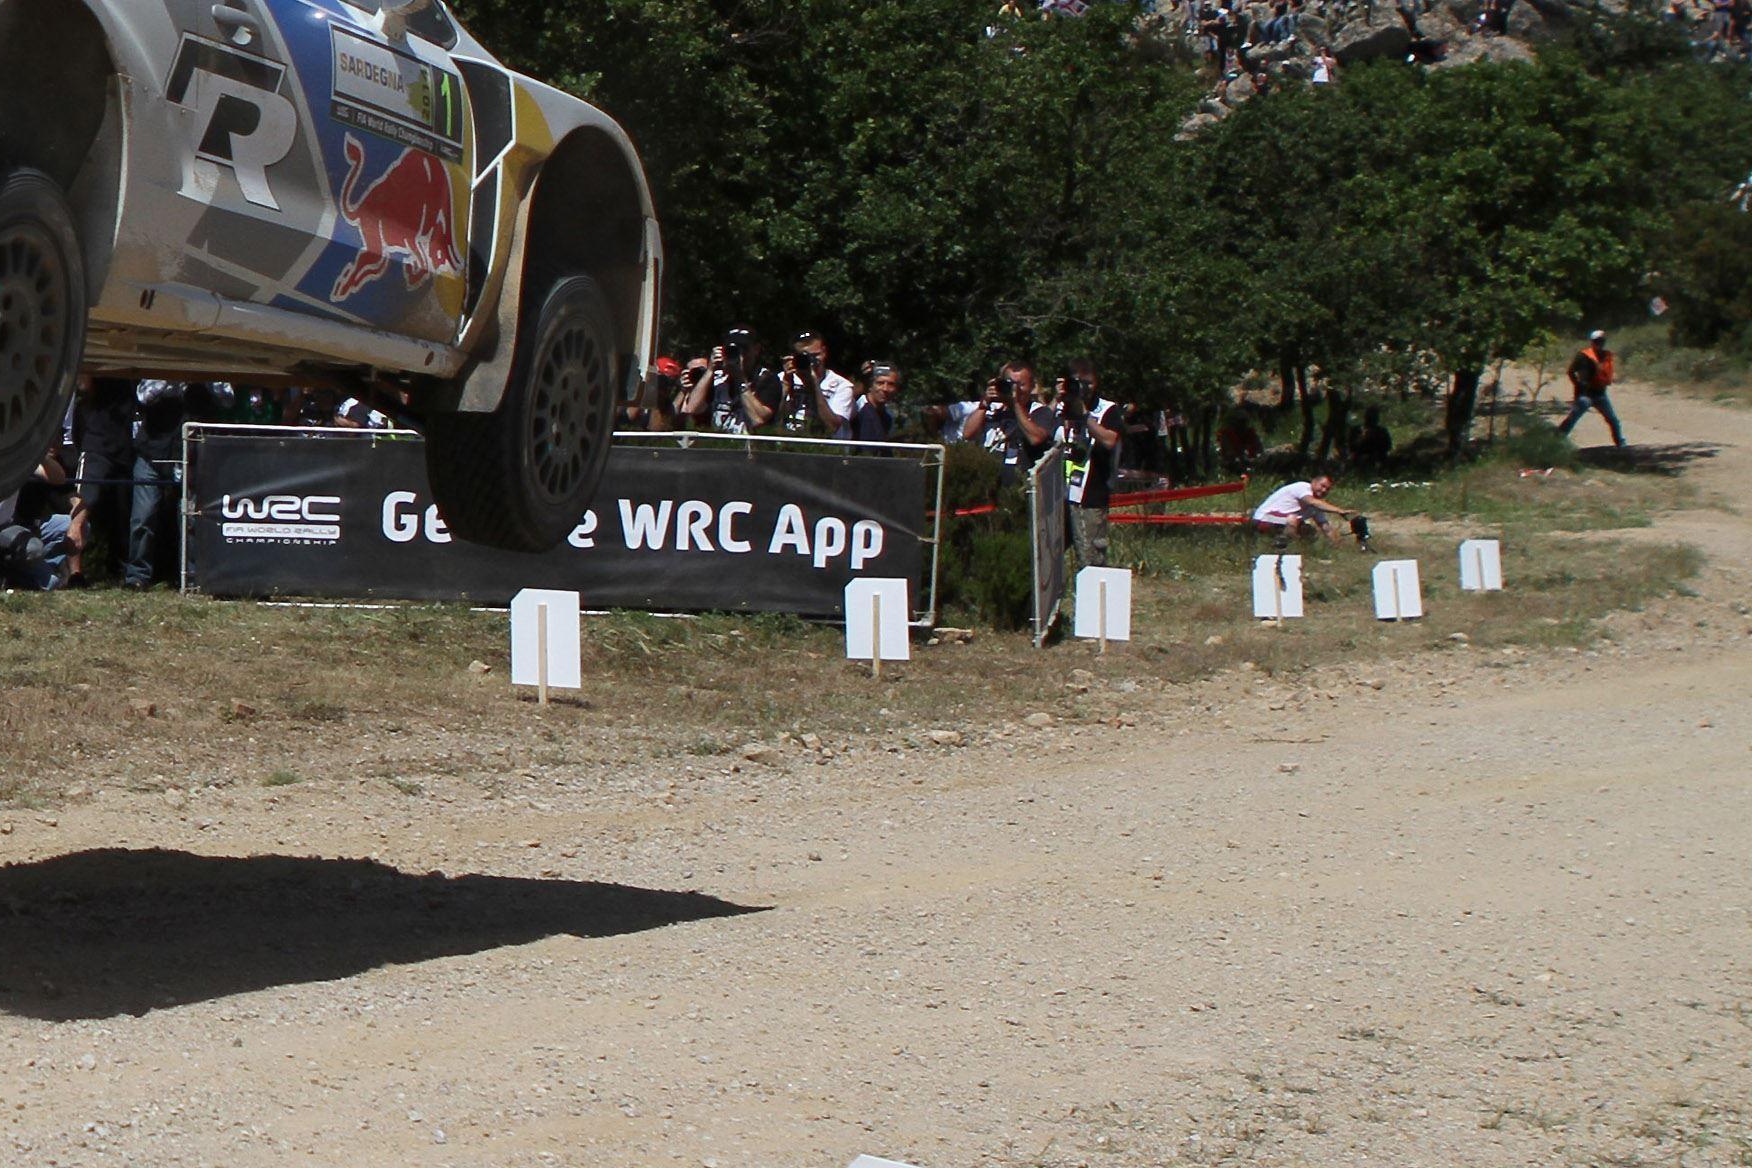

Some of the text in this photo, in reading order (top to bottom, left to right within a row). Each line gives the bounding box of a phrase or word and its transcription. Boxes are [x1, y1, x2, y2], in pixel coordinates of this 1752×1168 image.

[339, 52, 406, 93] SARDEGNA
[165, 30, 298, 213] R
[222, 494, 341, 521] WRC
[226, 537, 337, 547] CHAMPIONSHIP
[247, 526, 291, 535] WORLD
[294, 526, 336, 536] RALLY
[382, 491, 452, 543] Ge
[617, 498, 753, 553] WRC
[768, 503, 884, 570] App
